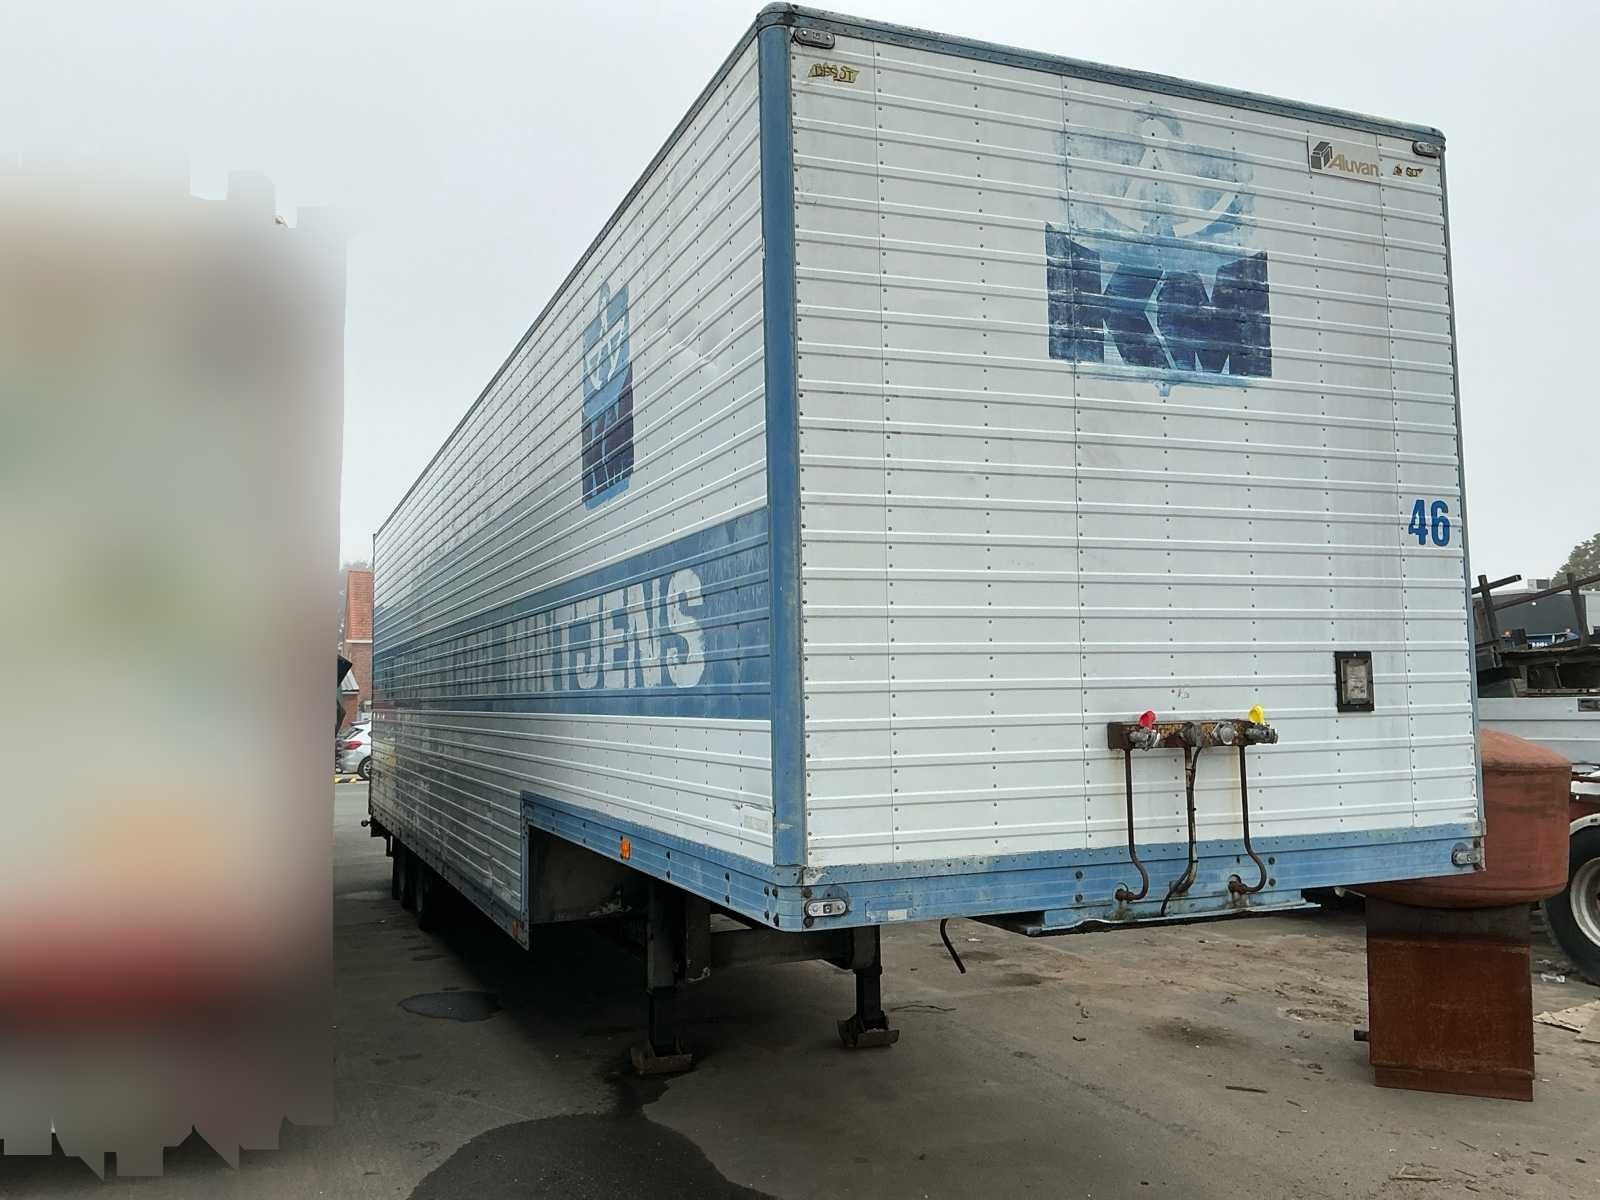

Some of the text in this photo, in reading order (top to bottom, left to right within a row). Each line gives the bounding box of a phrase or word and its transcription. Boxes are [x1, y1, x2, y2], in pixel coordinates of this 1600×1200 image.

[1327, 153, 1379, 177] Aluvan
[1408, 499, 1451, 547] 46
[505, 567, 705, 692] MINTJENS
